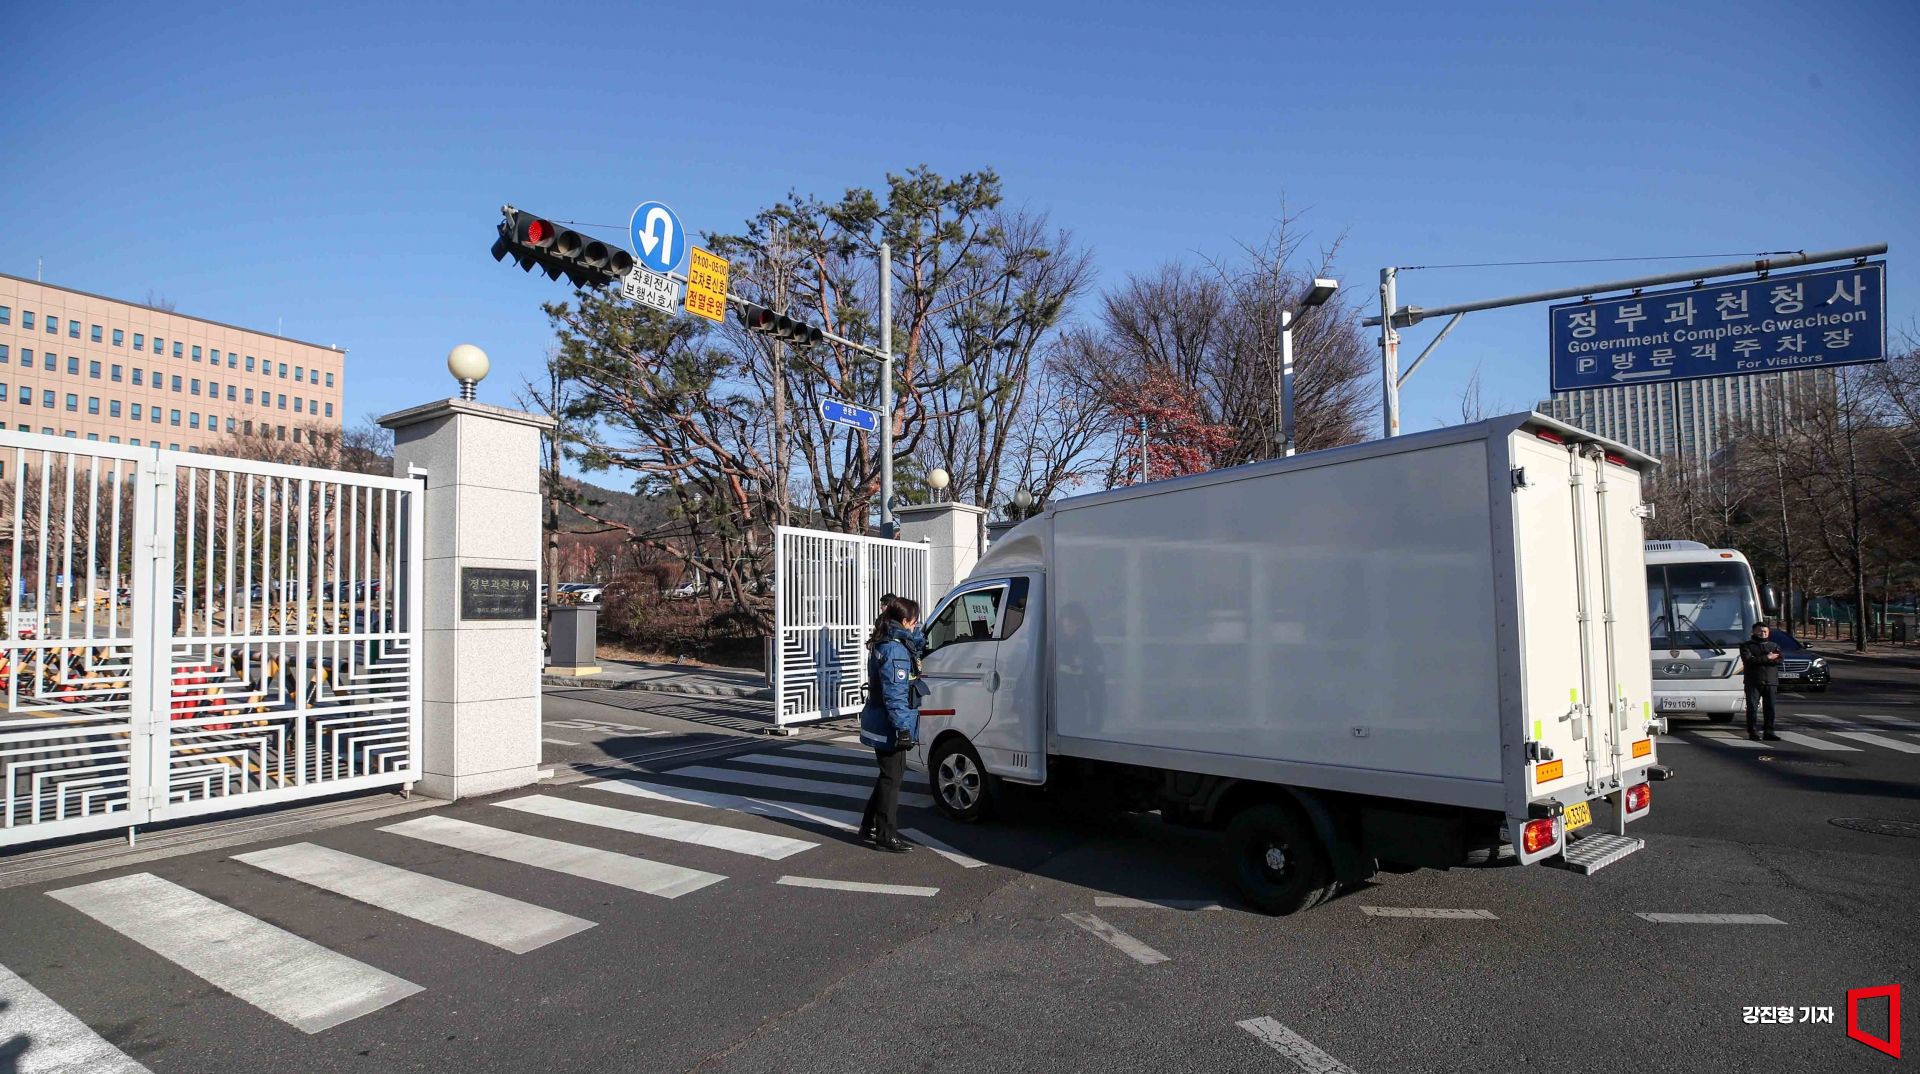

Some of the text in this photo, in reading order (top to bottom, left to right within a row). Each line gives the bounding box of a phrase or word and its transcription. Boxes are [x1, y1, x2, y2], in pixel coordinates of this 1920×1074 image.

[632, 269, 674, 295] 좌회전시
[691, 270, 725, 295] 교차로신호
[625, 283, 676, 312] 보행신호시
[688, 290, 723, 316] 점멸운영
[1567, 308, 1867, 354] Government Complex-Gwacheon
[1737, 352, 1823, 370] For Visitors
[469, 577, 530, 591] 정부과천청사
